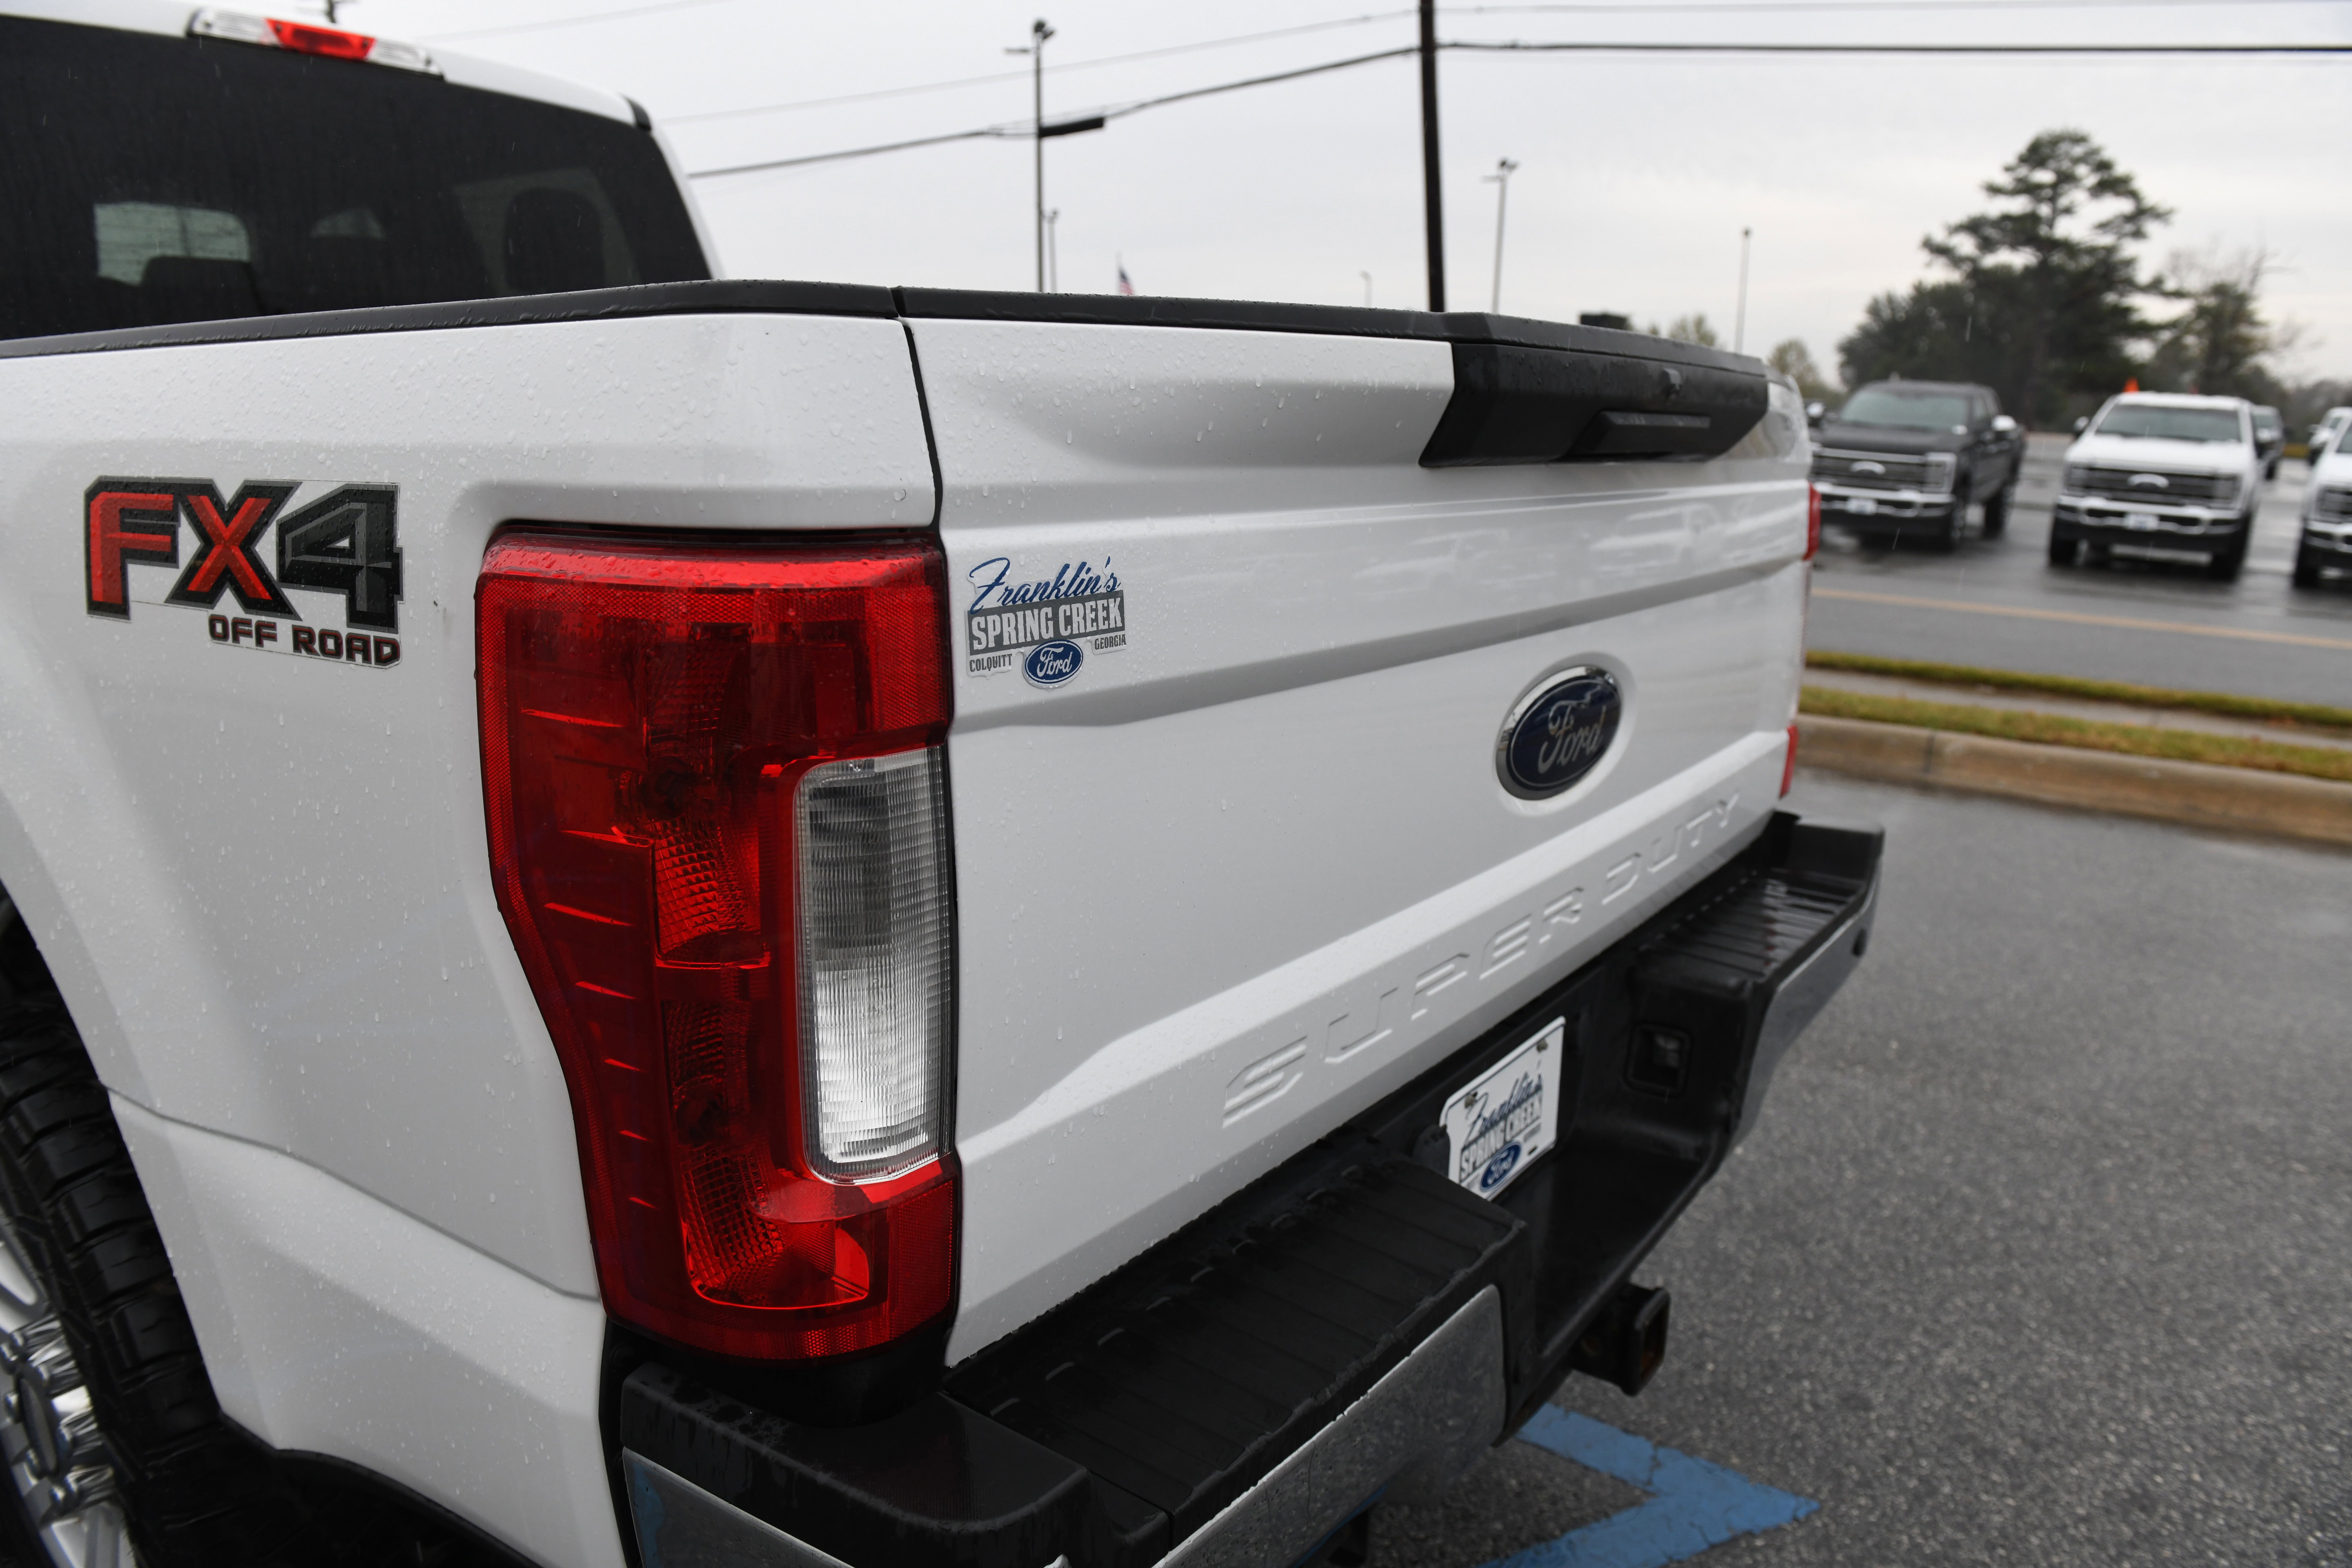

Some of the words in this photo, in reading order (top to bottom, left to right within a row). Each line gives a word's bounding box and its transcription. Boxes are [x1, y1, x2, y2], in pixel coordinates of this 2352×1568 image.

[84, 475, 404, 633] FX4
[969, 556, 1121, 615] Franklin's
[208, 614, 277, 647] OFF
[292, 624, 401, 666] ROAD
[971, 607, 1054, 650] SPRING
[1058, 597, 1123, 636] CREEK
[1094, 634, 1127, 650] GEORGIA
[969, 654, 1012, 672] COLQUITT
[1036, 647, 1073, 677] Ford
[1538, 691, 1606, 774] Ford
[1223, 887, 1584, 1128] SUPER
[1602, 788, 1740, 905] DUTY
